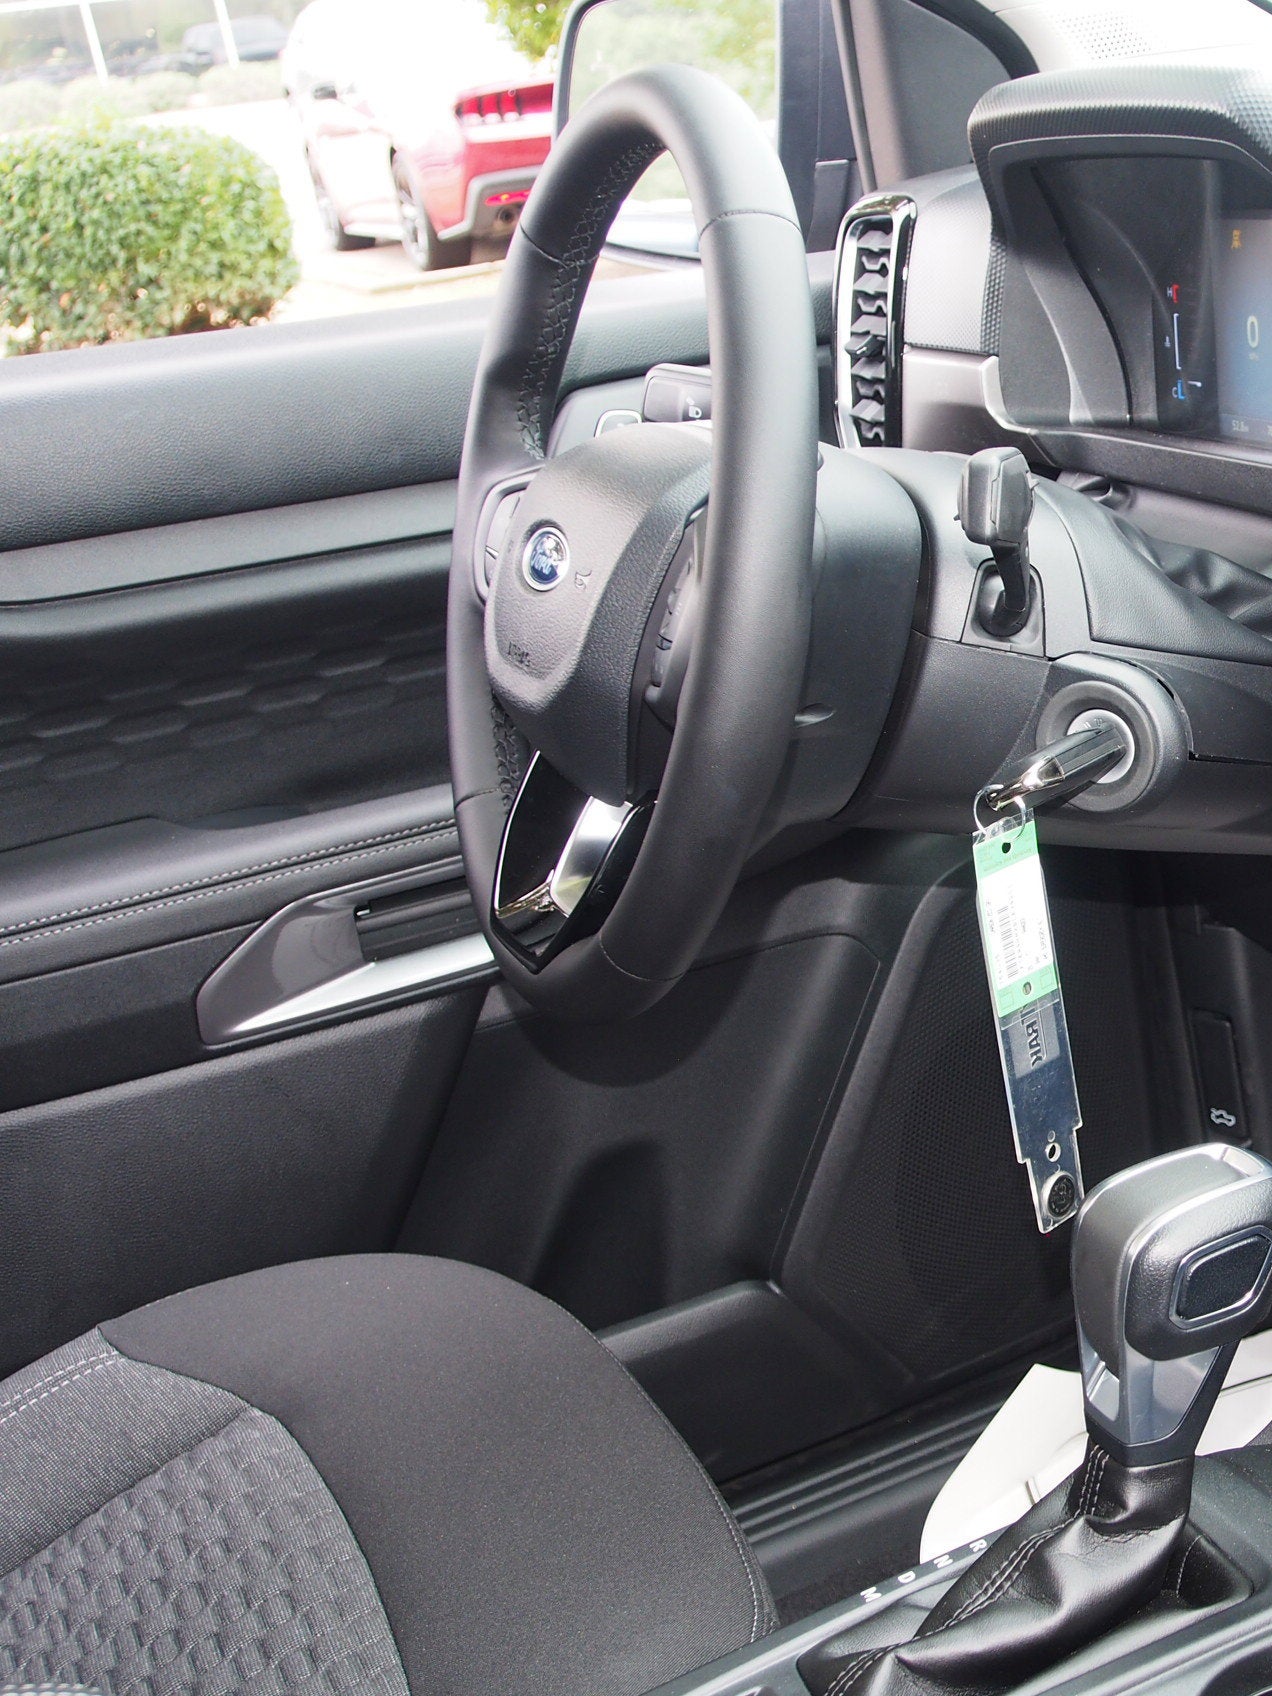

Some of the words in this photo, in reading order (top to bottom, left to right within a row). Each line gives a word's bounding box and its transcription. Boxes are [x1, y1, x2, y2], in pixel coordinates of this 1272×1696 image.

[1247, 315, 1259, 348] 0
[969, 1538, 988, 1552] R
[933, 1554, 954, 1568] N
[897, 1570, 916, 1584] D
[860, 1586, 882, 1603] M
